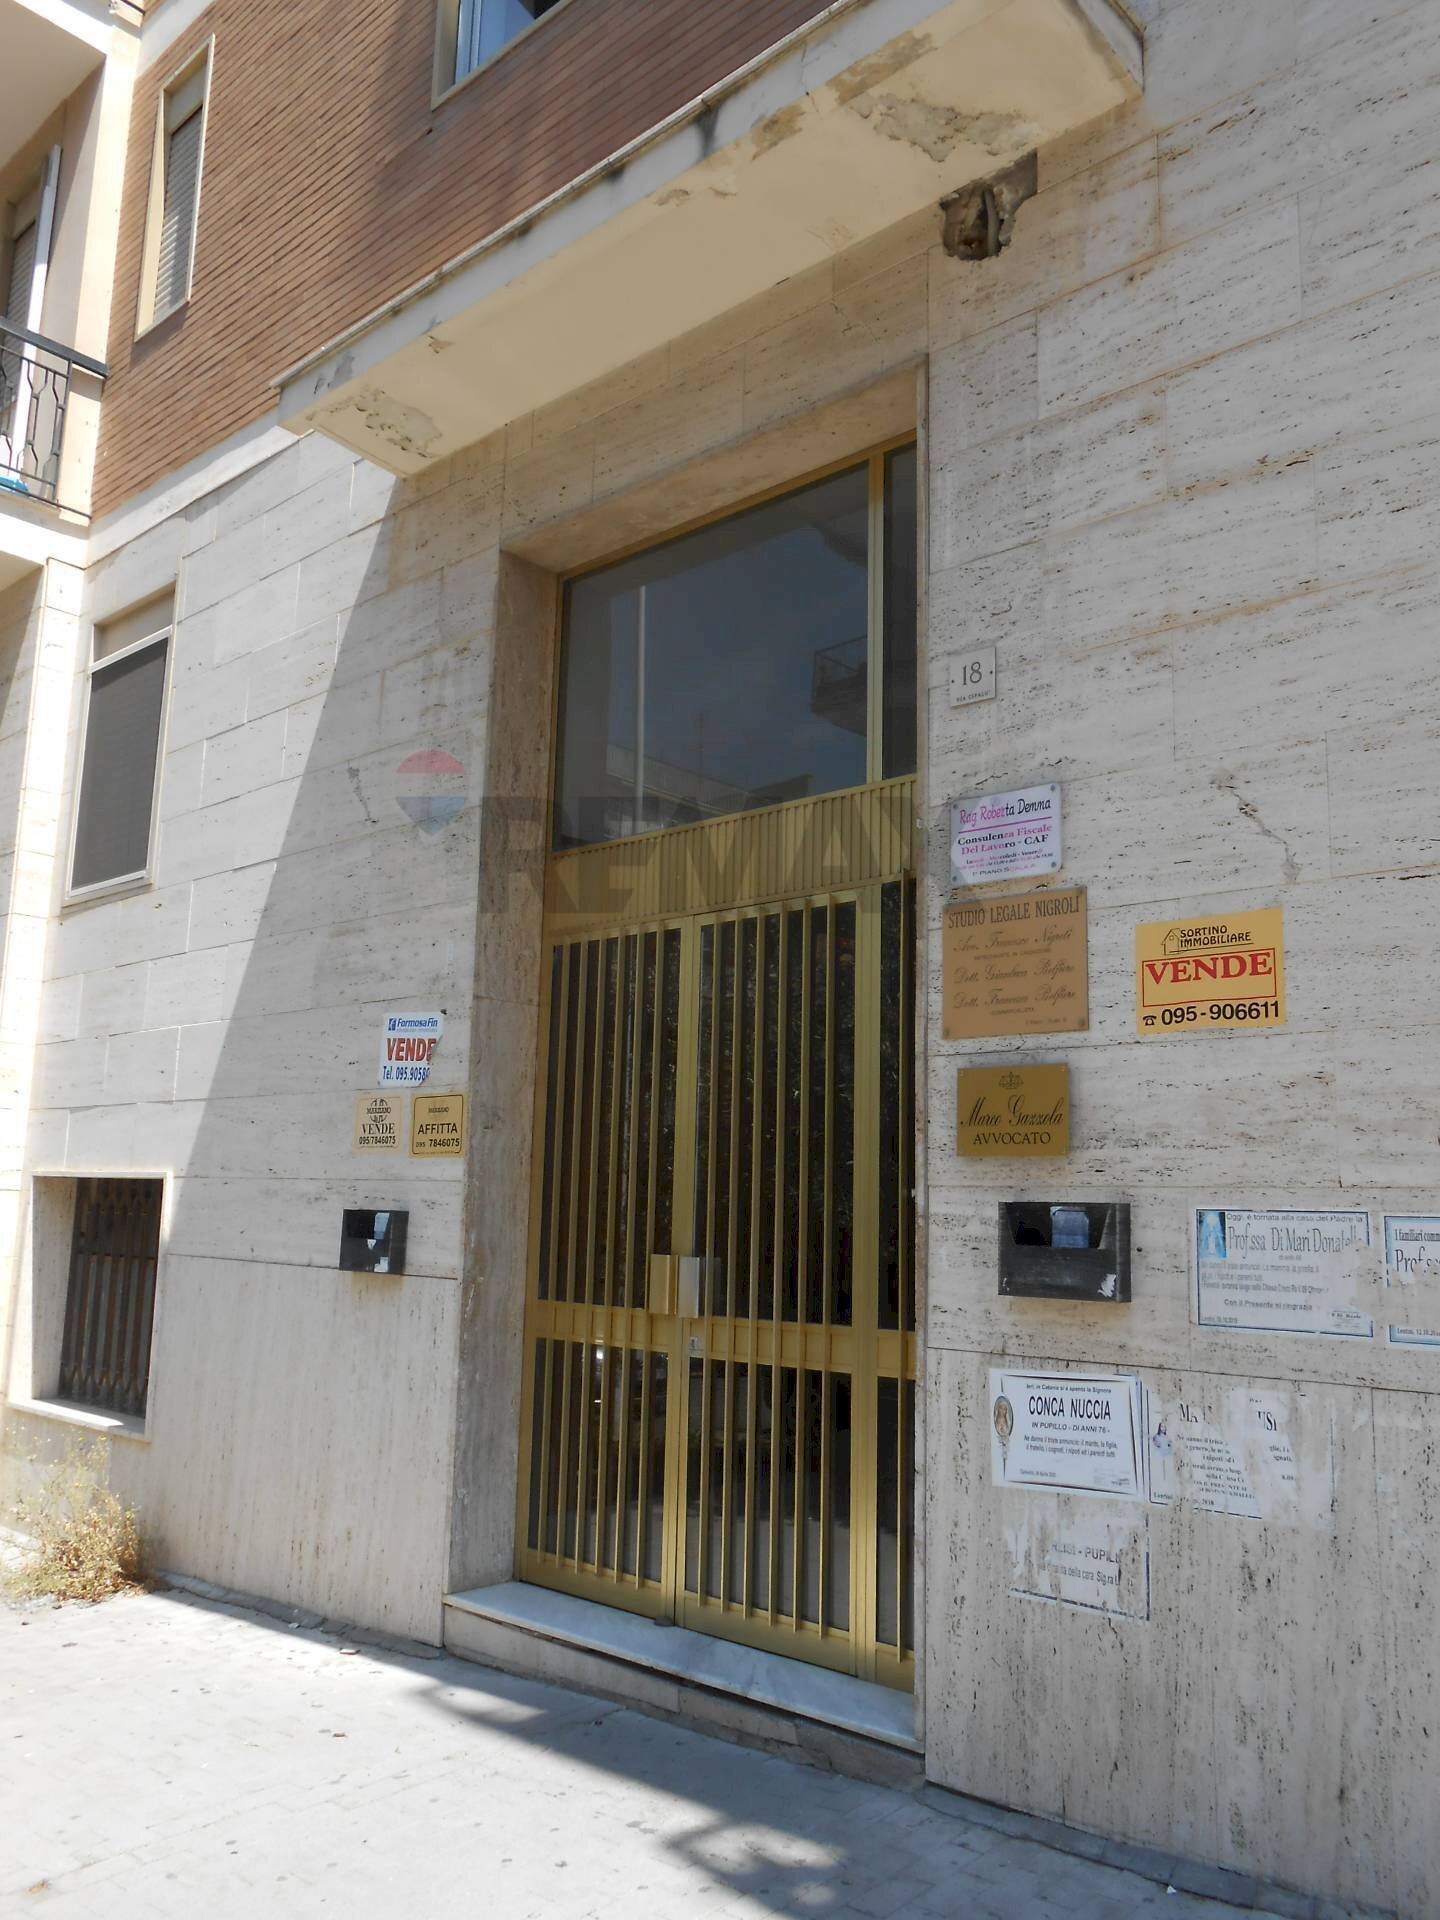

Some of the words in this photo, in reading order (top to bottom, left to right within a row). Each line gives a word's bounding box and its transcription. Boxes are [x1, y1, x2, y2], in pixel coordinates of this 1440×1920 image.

[962, 661, 982, 685] 18
[960, 809, 976, 827] Rag
[980, 803, 1015, 821] Roberta
[1018, 798, 1051, 815] Demma
[958, 831, 1014, 845] Consulenza
[1018, 824, 1052, 836] Fiscale
[961, 846, 978, 855] Del
[982, 841, 1016, 852] Lavoro
[1024, 834, 1049, 845] CAF
[949, 908, 985, 929] STUDIO
[990, 903, 1030, 923] LEGALE
[1035, 896, 1079, 918] NIGROLI
[1179, 925, 1228, 939] SORTINO
[1180, 931, 1252, 948] IMMOBILIARE
[1145, 951, 1272, 985] VENDE
[383, 1066, 393, 1080] Tel.
[361, 1122, 394, 1135] VENDE
[418, 1122, 457, 1135] AFFITTA
[429, 1137, 460, 1148] 7846075
[973, 1131, 1052, 1146] AVVOCATO
[1271, 1226, 1285, 1251] Di
[1029, 1396, 1065, 1417] CONCA
[1070, 1399, 1111, 1420] NUCCIA
[1040, 1422, 1067, 1430] PUPILLO
[1080, 1425, 1097, 1433] ANNI
